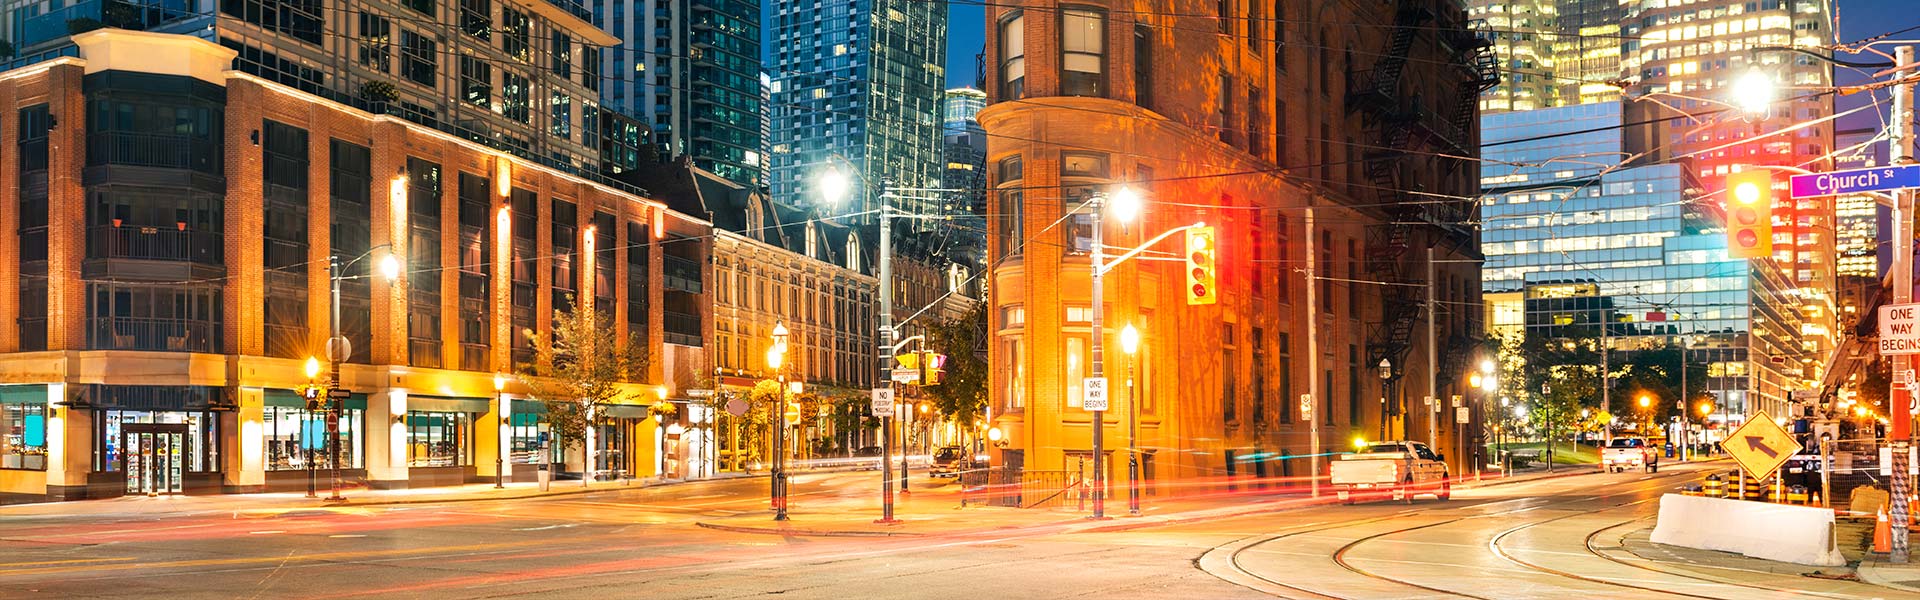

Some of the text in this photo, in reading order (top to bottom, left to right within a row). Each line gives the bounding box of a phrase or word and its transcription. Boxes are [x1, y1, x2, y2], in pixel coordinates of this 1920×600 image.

[1816, 169, 1894, 191] Church St
[1890, 308, 1913, 320] ONE
[1890, 323, 1913, 335] WAY
[1089, 380, 1101, 388] ONE
[879, 391, 888, 400] NO
[1089, 390, 1101, 398] WAY
[1085, 400, 1106, 408] BEGINS
